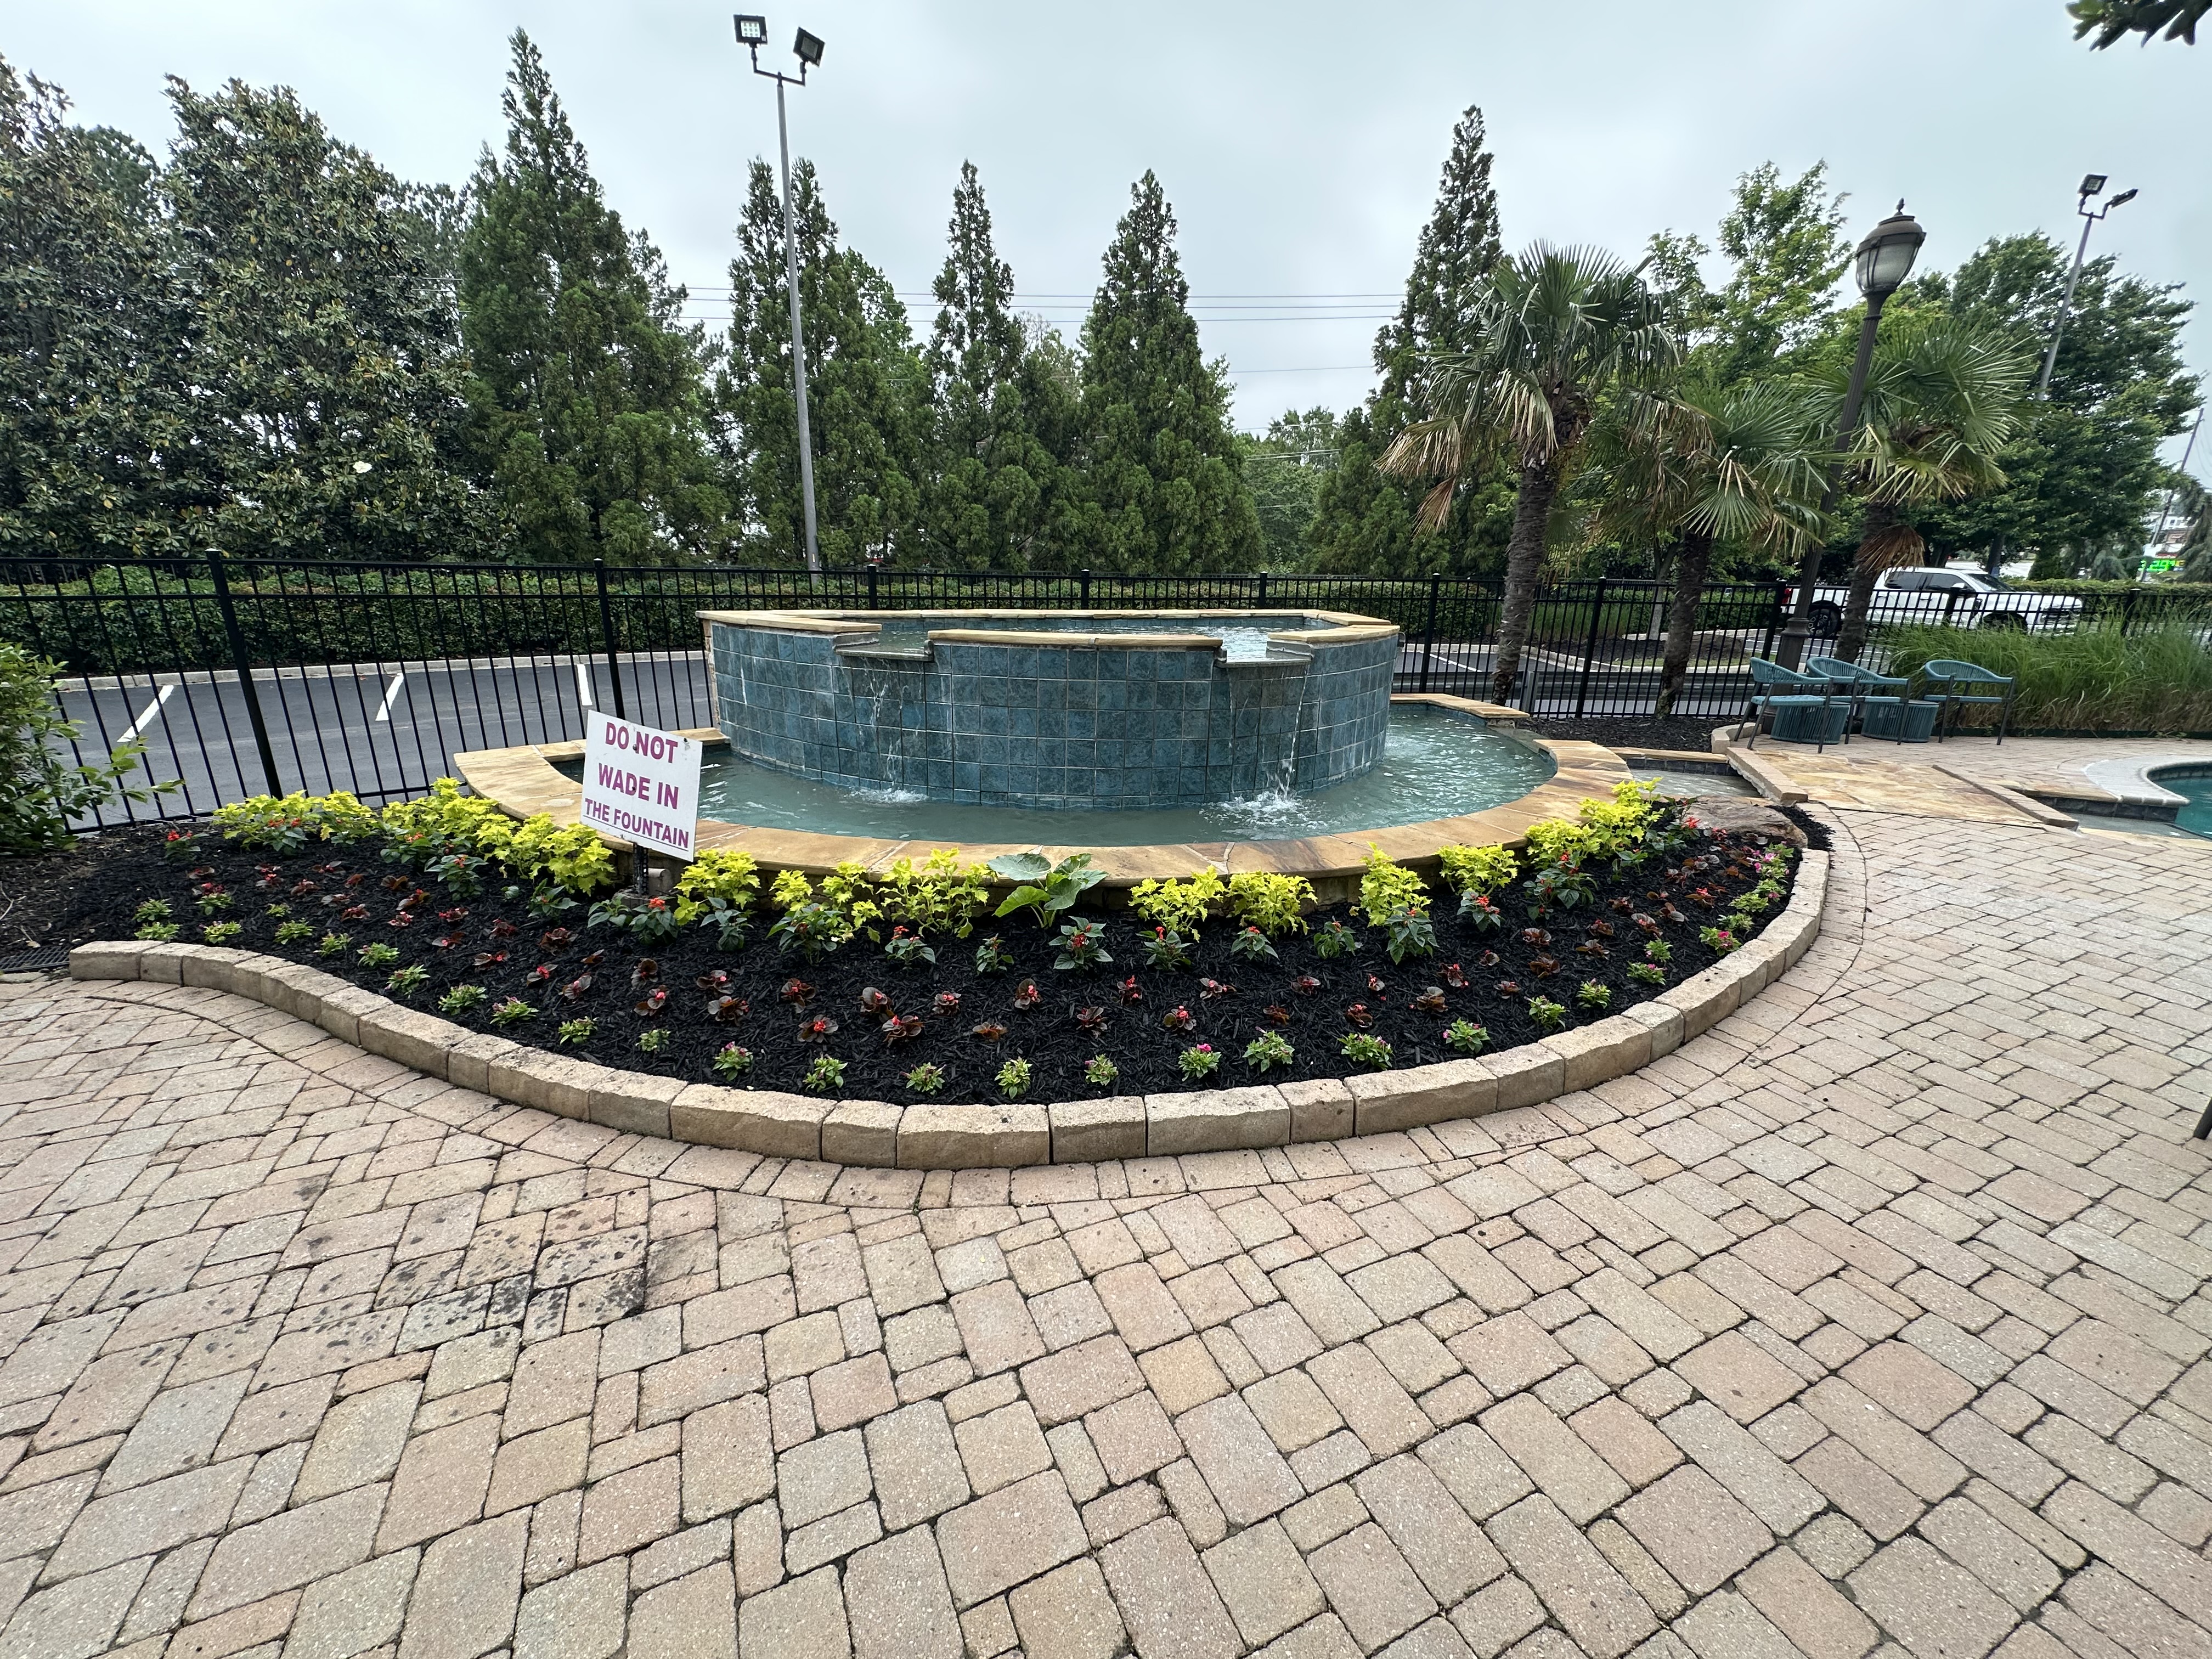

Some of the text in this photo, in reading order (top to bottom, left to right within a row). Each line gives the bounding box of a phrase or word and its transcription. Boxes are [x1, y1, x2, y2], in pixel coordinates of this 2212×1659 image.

[605, 721, 678, 763] DO NOT
[598, 762, 679, 809] WADE IN
[585, 798, 689, 848] THE FOUNTAIN
